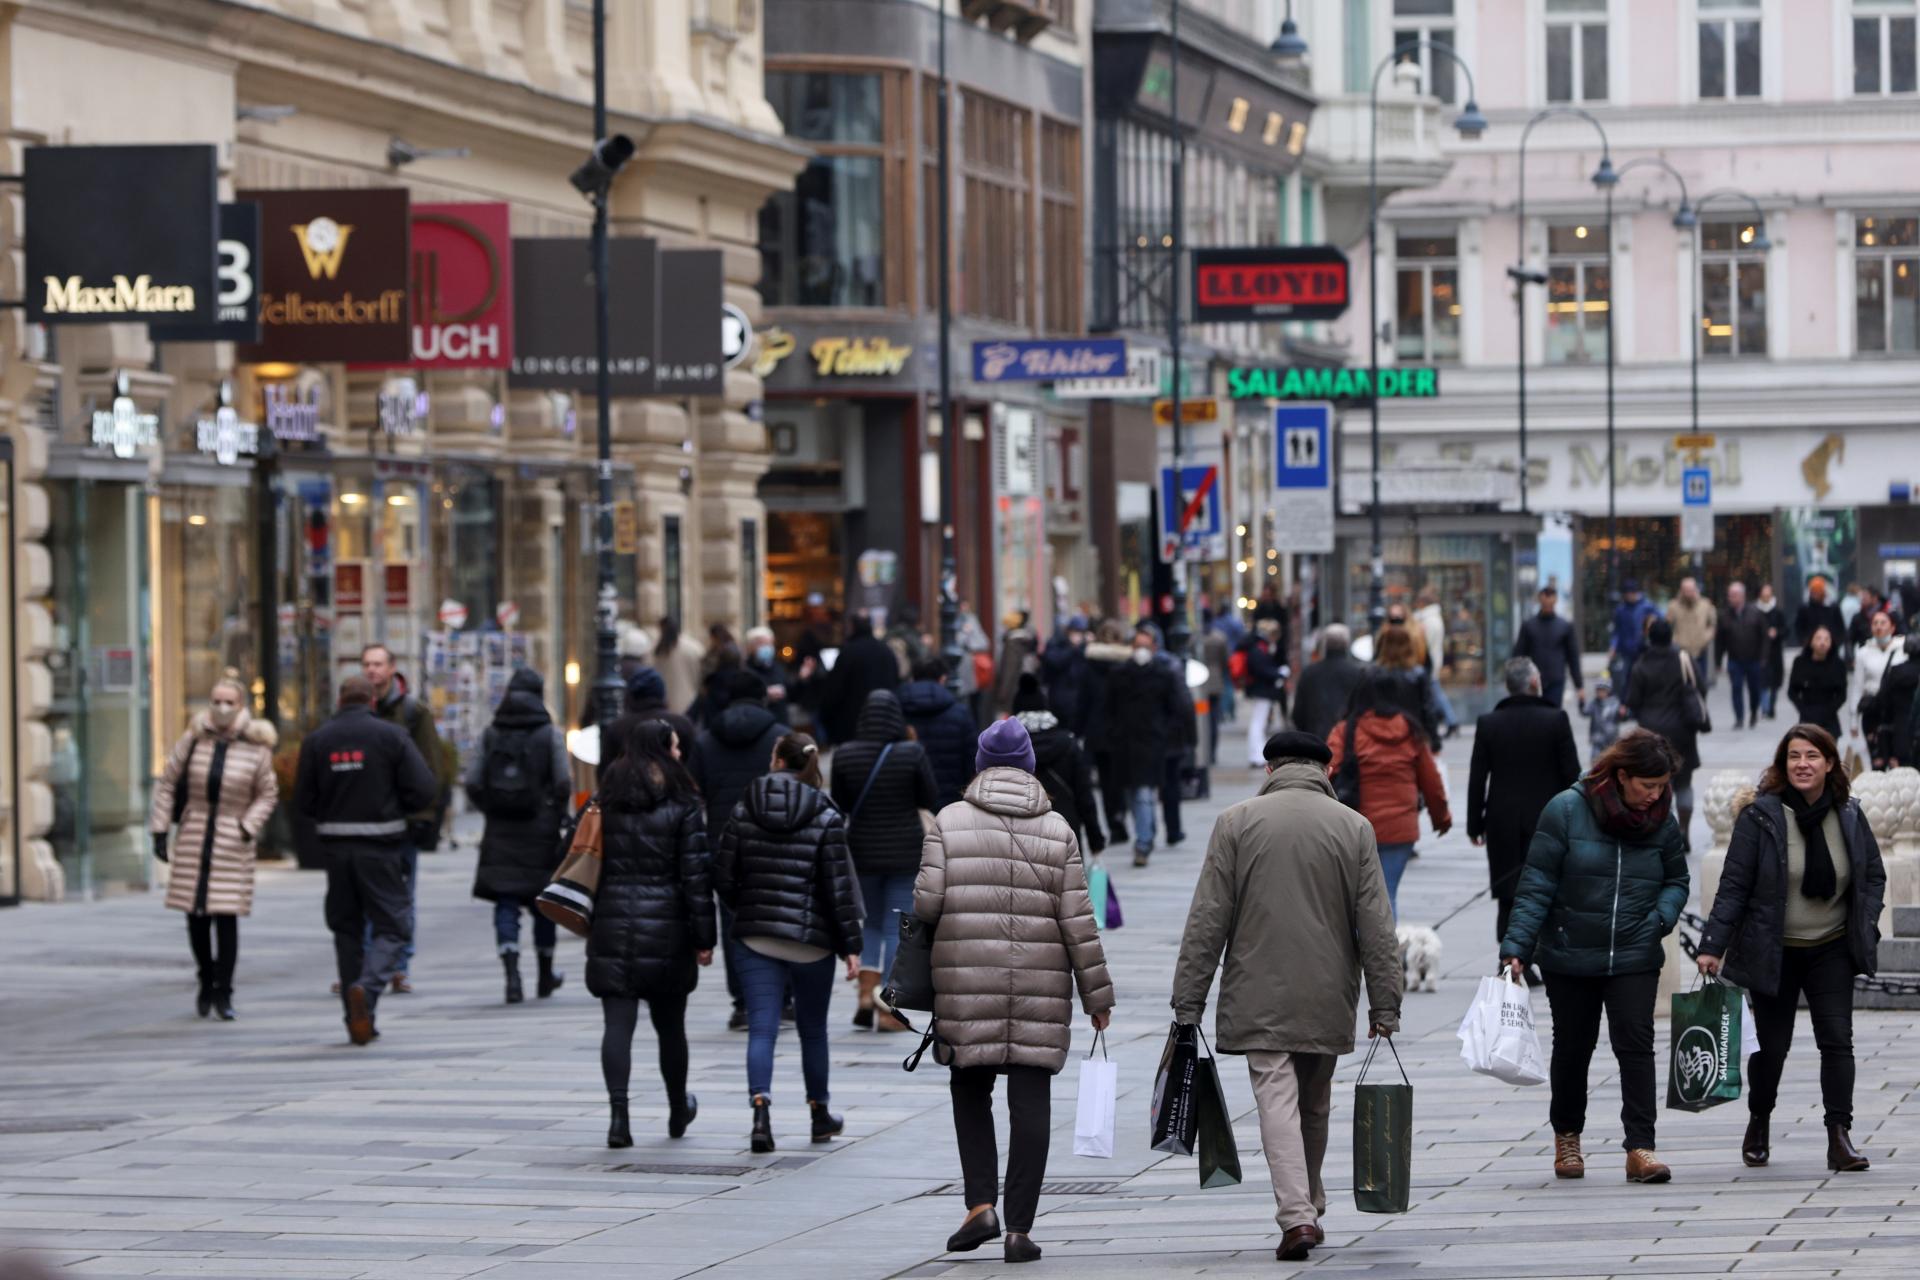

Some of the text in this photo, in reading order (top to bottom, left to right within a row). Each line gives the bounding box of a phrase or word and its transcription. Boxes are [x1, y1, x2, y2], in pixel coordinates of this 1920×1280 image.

[43, 275, 196, 314] MaxMara
[1207, 272, 1338, 297] LLOYD
[258, 289, 405, 325] ellendorff
[410, 323, 499, 360] UCH
[1020, 346, 1120, 376] Tchibo
[1227, 366, 1437, 399] SALAMANDER
[1719, 1013, 1730, 1081] SALAMANDER
